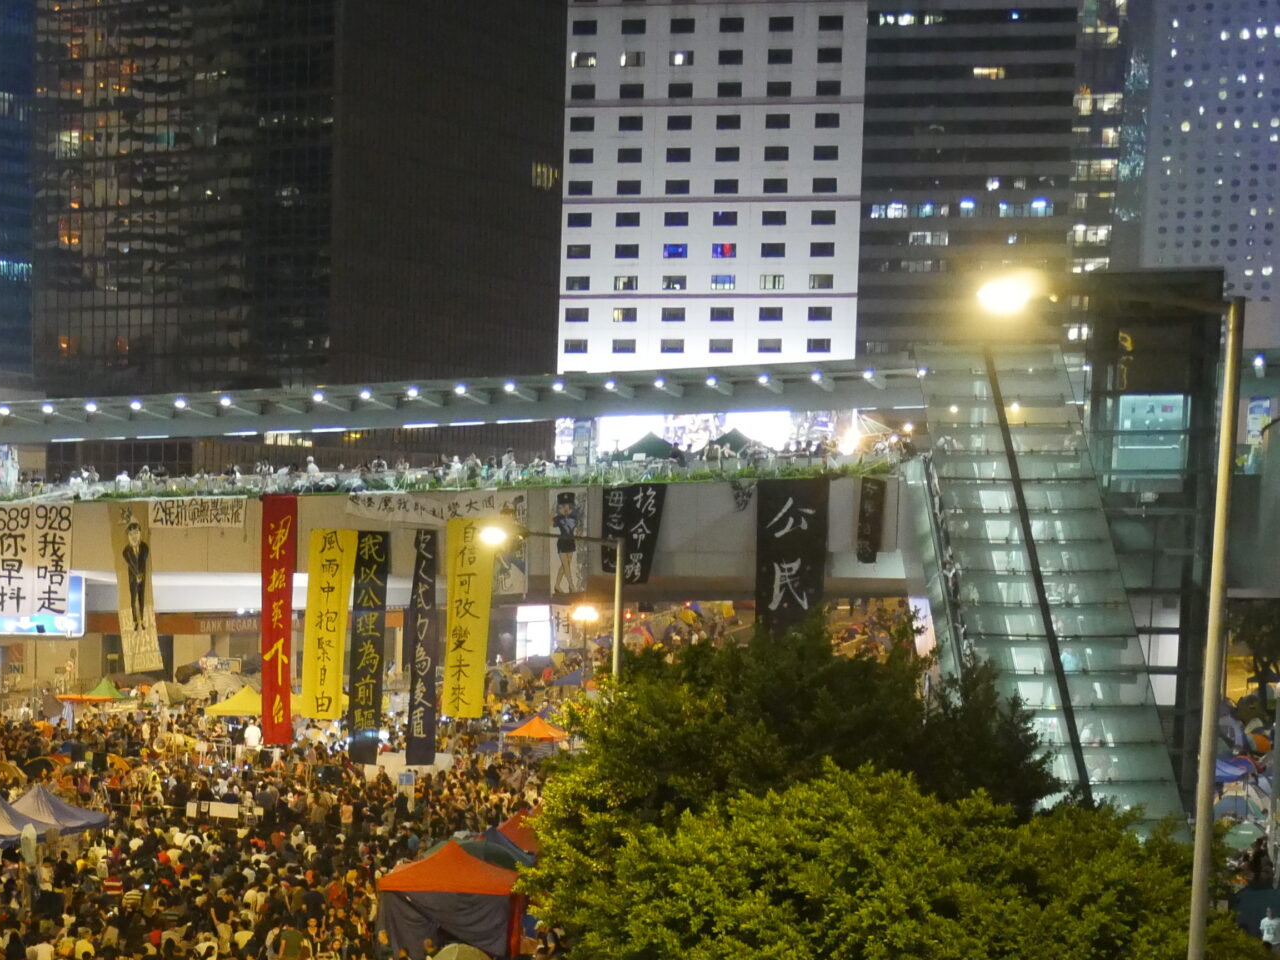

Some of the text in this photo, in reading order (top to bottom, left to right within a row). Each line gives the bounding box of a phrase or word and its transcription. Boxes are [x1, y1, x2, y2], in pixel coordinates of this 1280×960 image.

[37, 532, 67, 614] 我唔走
[200, 618, 258, 633] BANK NEGARA
[263, 515, 292, 724] 梁振英下台
[315, 530, 344, 714] 風雨中抱緊自由
[354, 534, 386, 731] 我以公理為前驅
[449, 522, 480, 713] 自信可改變未來
[766, 497, 816, 611] 公民
